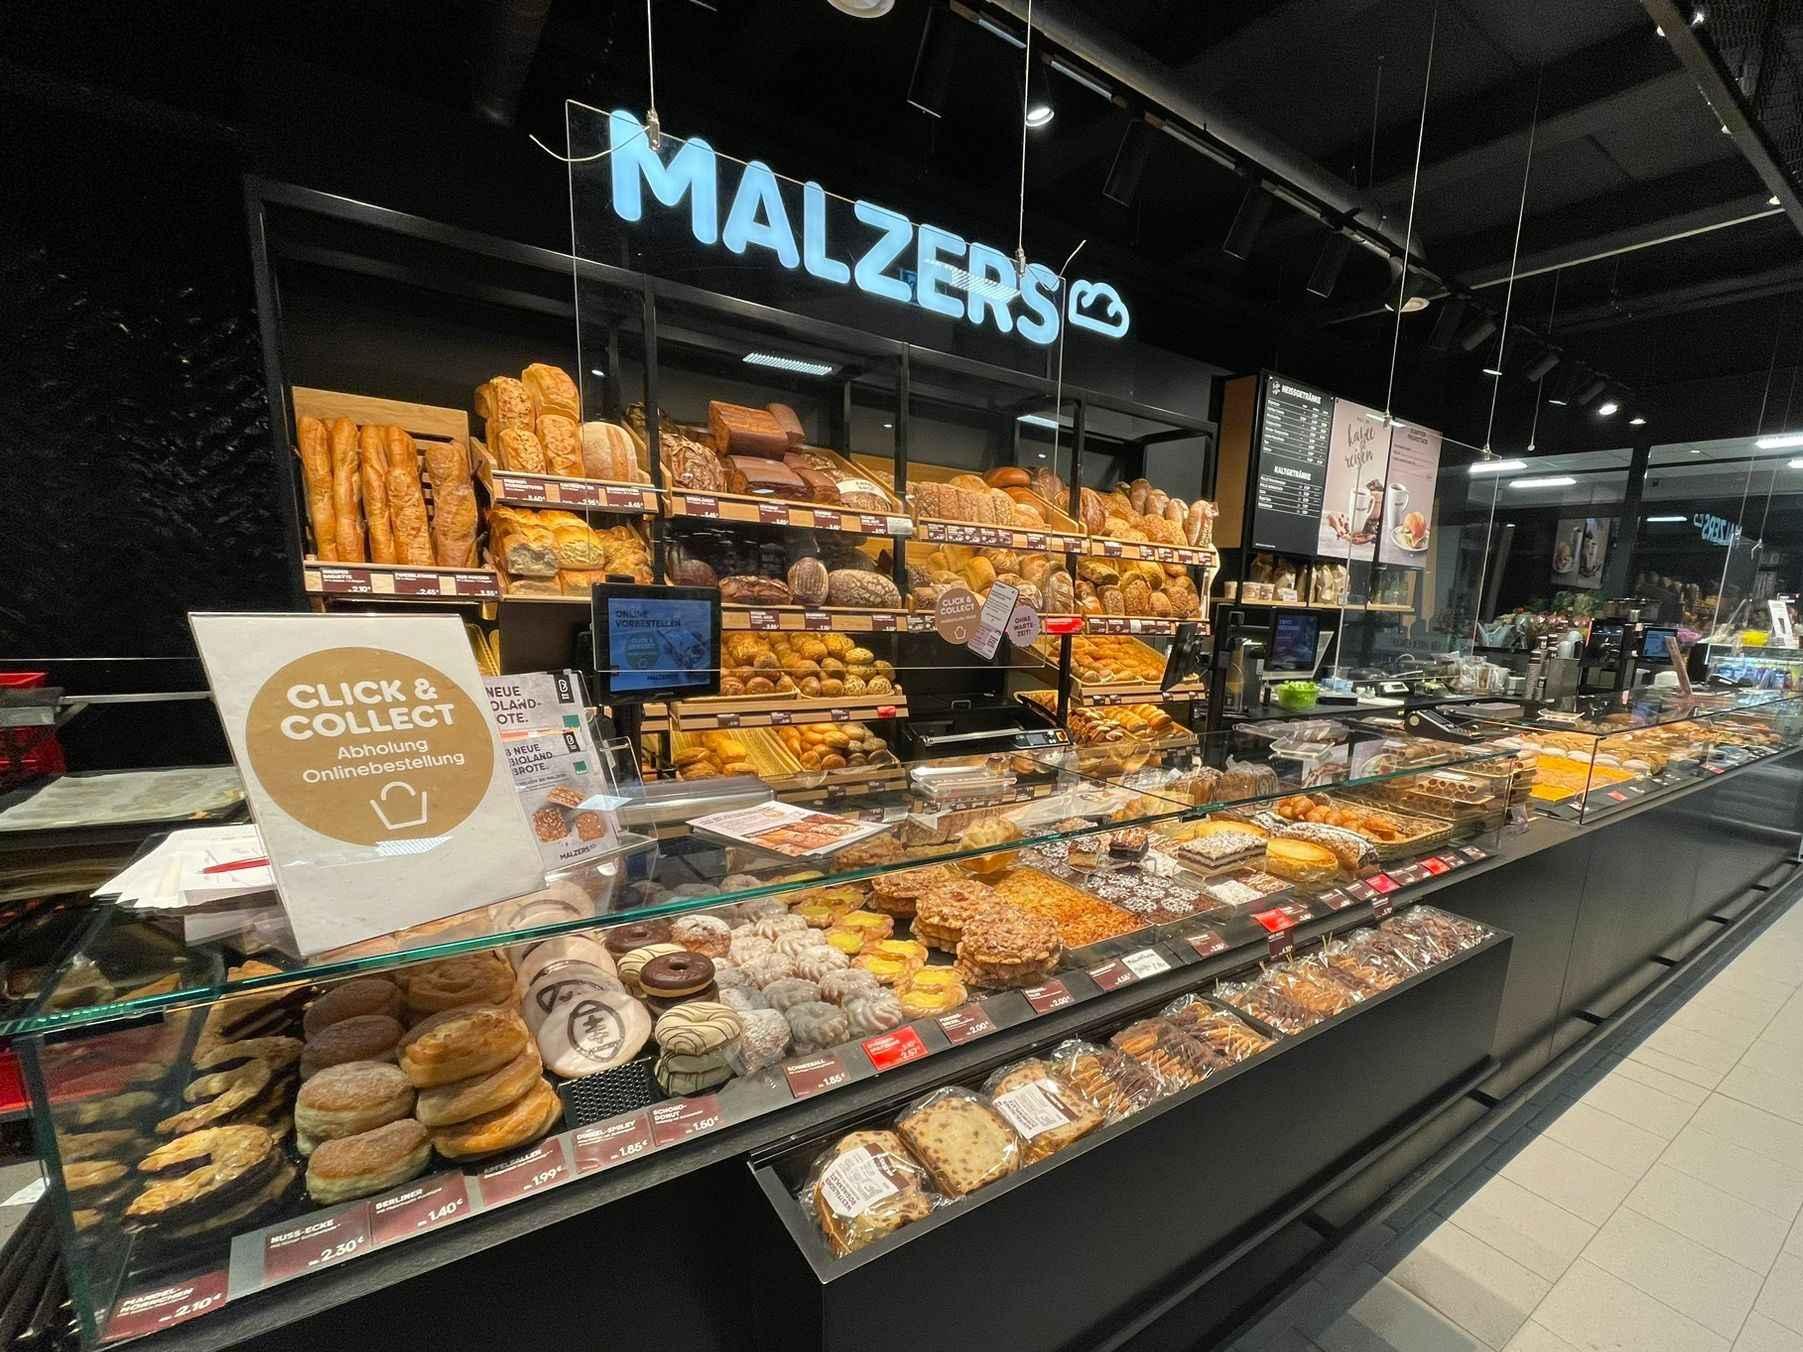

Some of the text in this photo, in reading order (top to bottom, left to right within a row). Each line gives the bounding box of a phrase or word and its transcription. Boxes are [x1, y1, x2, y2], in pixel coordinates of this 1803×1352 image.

[609, 110, 1060, 345] MALZERS
[940, 602, 975, 615] COLLECT
[942, 597, 963, 607] CLICK
[287, 678, 439, 709] CLICK &
[486, 686, 521, 698] NEUE
[280, 703, 455, 741] COLLECT
[337, 739, 429, 760] Abholung
[513, 743, 540, 755] NEUE
[302, 752, 466, 784] Onlinebestellung
[532, 1165, 563, 1186] 1.99€
[376, 1188, 423, 1210] BERLINER
[428, 1198, 464, 1221] 1.40€
[270, 1218, 335, 1244] NUSS-ECKE
[320, 1235, 365, 1263] 2.30€
